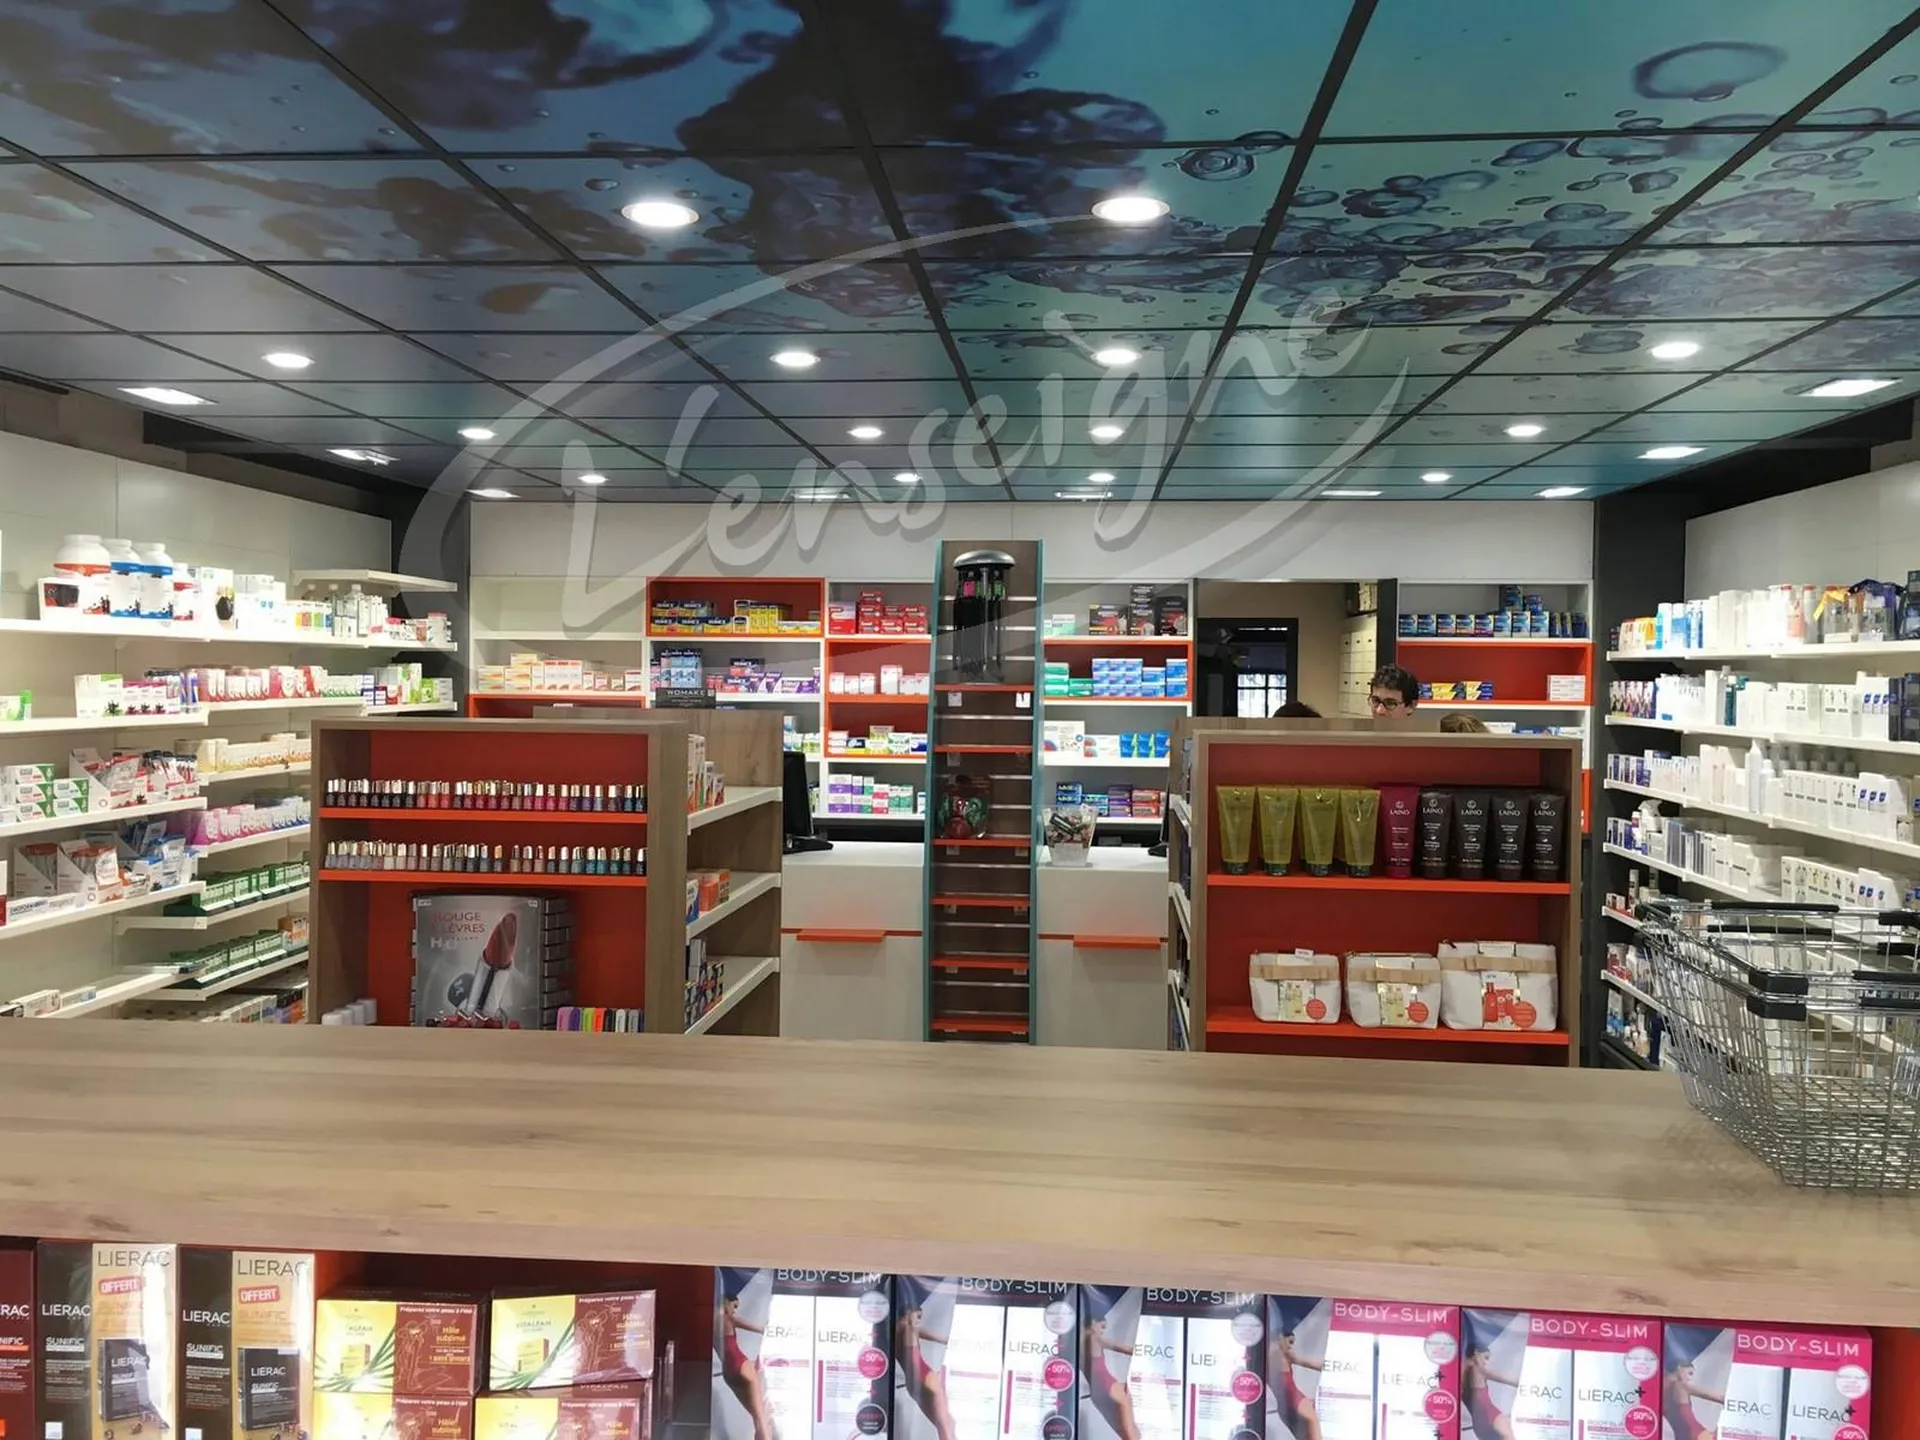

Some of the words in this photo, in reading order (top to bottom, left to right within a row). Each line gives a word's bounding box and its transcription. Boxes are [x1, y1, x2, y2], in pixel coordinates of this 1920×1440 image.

[1423, 807, 1444, 815] LAINO
[1461, 808, 1483, 817] LAINO
[1499, 809, 1521, 817] LAINO
[1534, 809, 1556, 817] LAINO
[97, 1250, 171, 1268] LIERAC
[237, 1259, 308, 1277] LIERAC
[777, 1268, 882, 1284] BODY-SLIM
[101, 1279, 140, 1293] OFFERT
[961, 1277, 1068, 1294] BODY-SLIM
[240, 1288, 278, 1302] OFFERT
[1146, 1287, 1256, 1305] BODY-SLIM
[0, 1304, 30, 1317] RAC
[42, 1304, 92, 1317] LIERAC
[182, 1309, 231, 1325] LIERAC
[1334, 1302, 1448, 1323] BODY-SLIM
[1531, 1317, 1648, 1339] BODY-SLIM
[1008, 1340, 1059, 1356] LIERAC
[1737, 1333, 1860, 1357] BODY-SLIM
[251, 1366, 287, 1377] LIERAC
[1382, 1372, 1438, 1389] LIEAC
[1578, 1387, 1636, 1405] LIERAC
[1792, 1405, 1852, 1423] LIERAC
